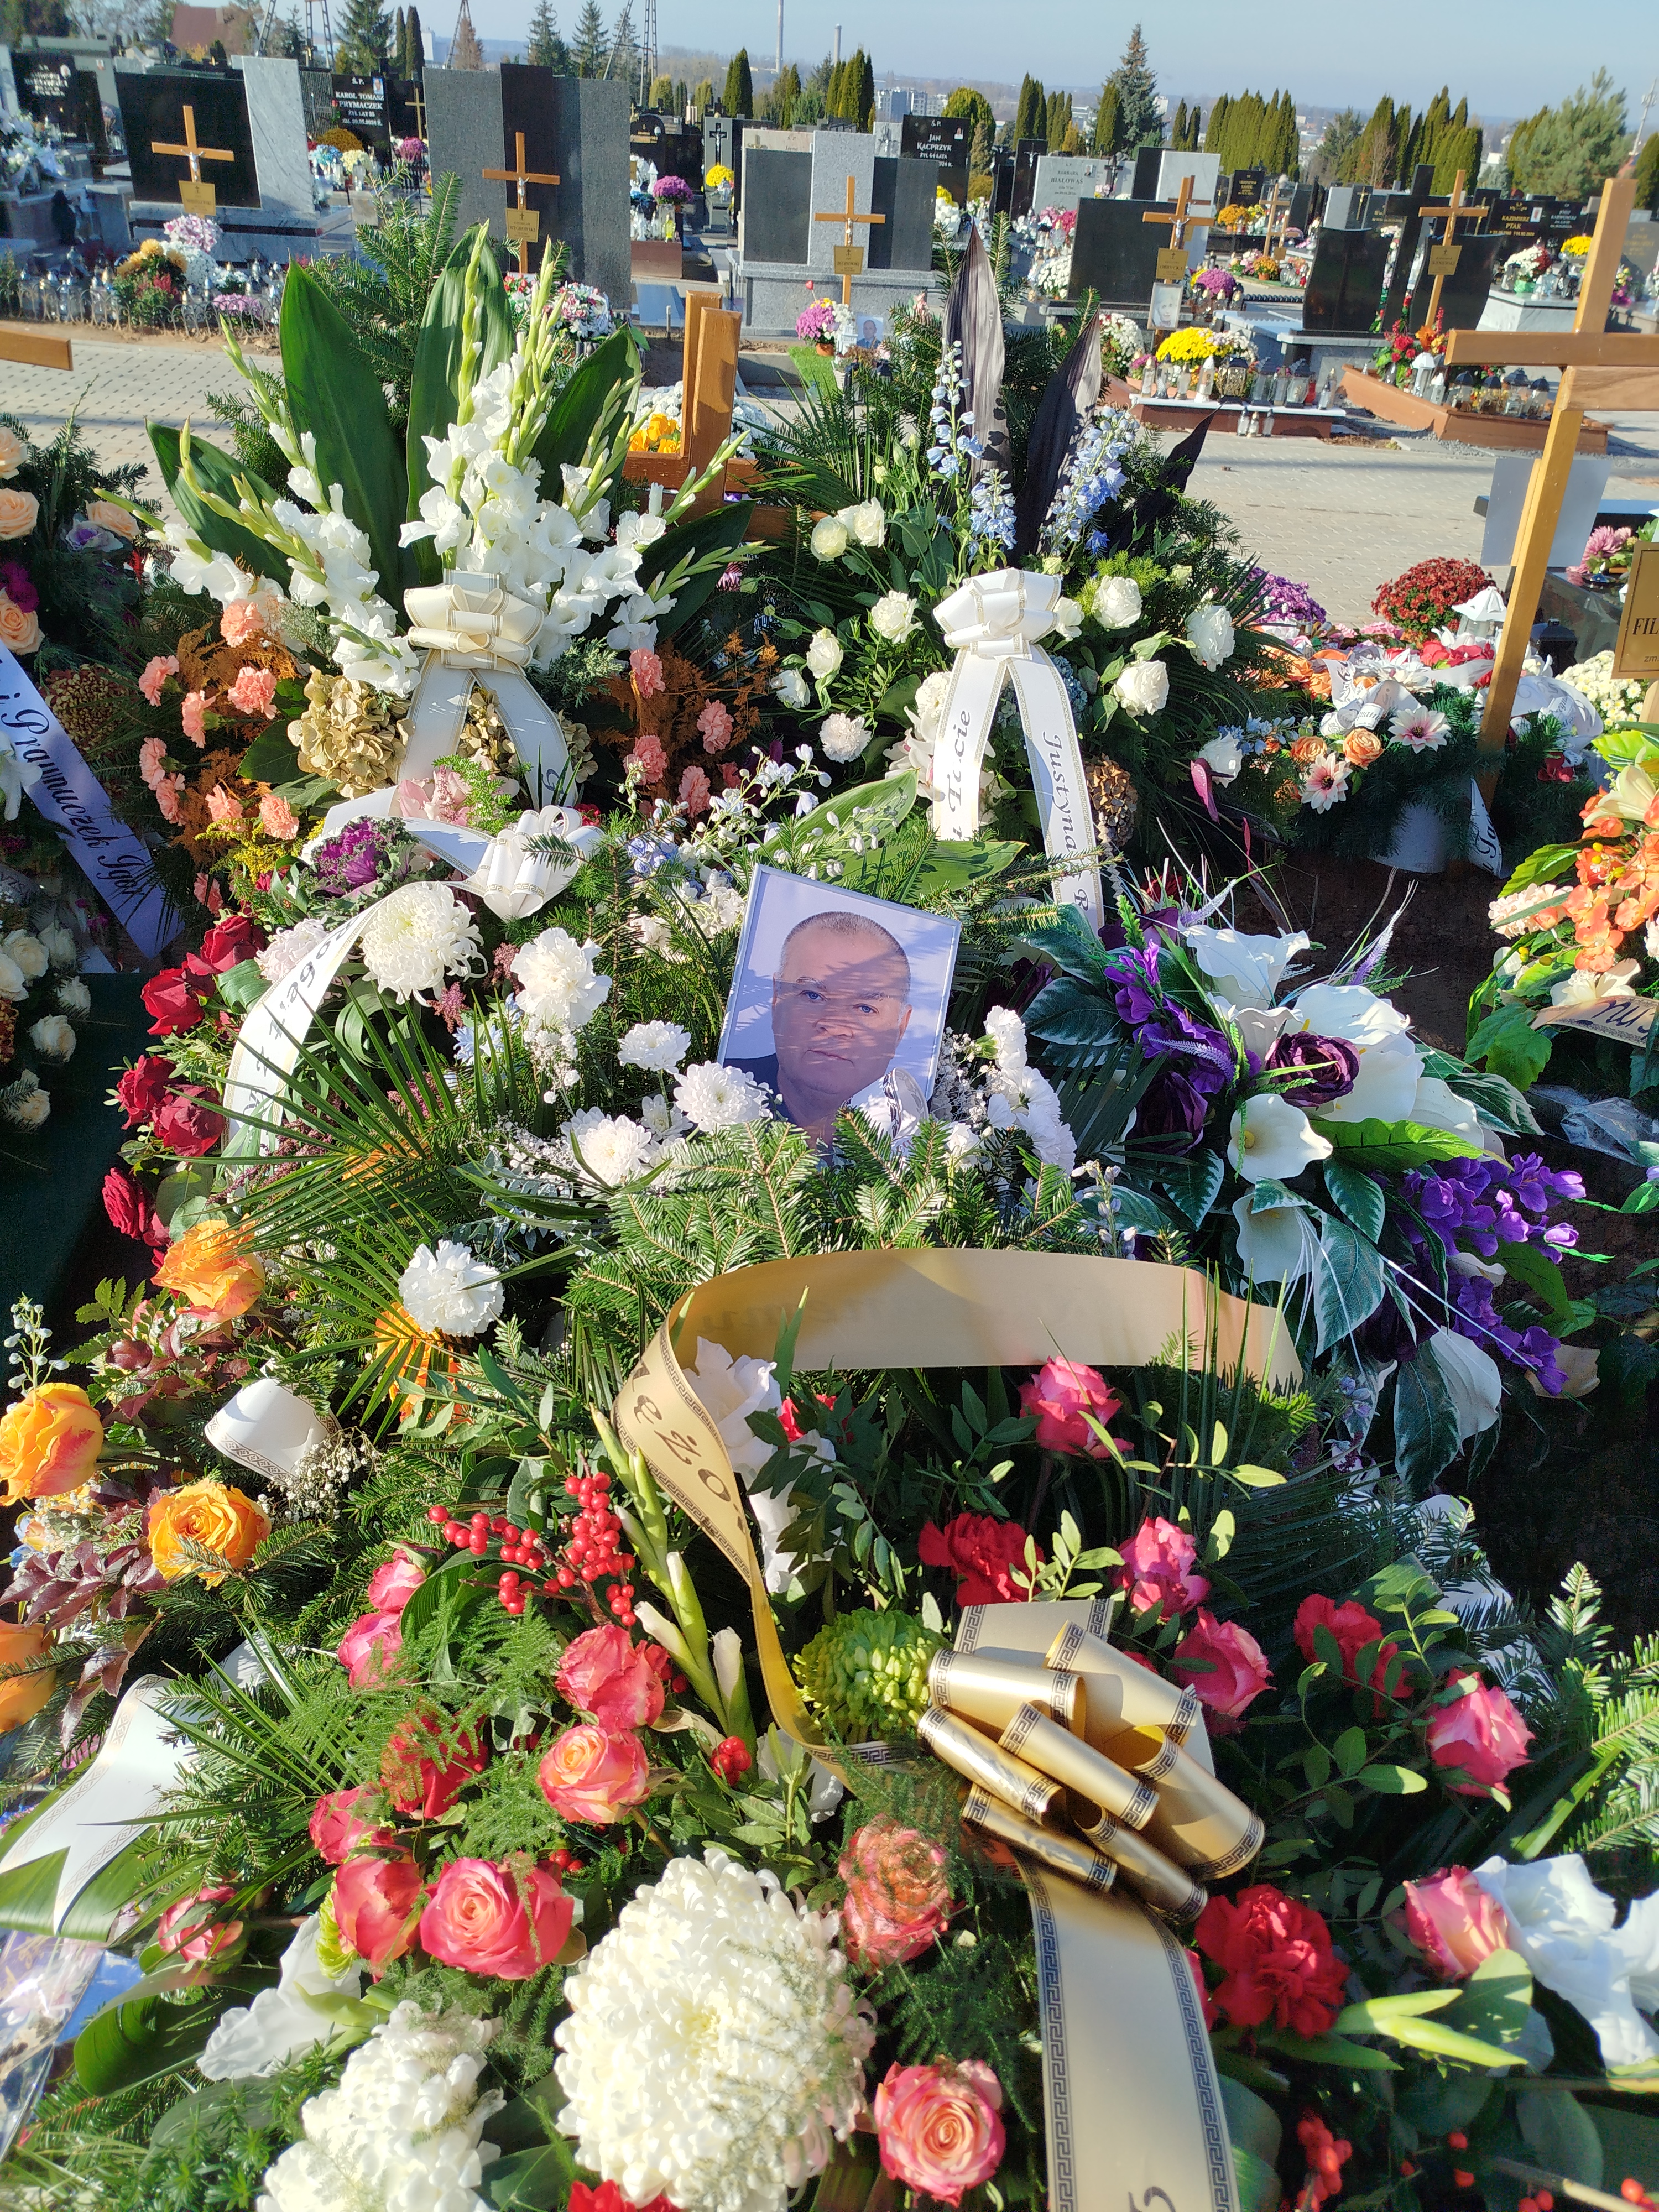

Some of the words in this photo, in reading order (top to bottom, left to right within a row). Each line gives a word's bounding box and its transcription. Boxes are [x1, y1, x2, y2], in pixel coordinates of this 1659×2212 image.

[358, 92, 384, 101] TOMASZ
[338, 101, 383, 110] PRYMACZEK
[928, 134, 941, 142] JAN
[1, 709, 119, 849] Prawnuczek
[1042, 731, 1078, 852] Justyna
